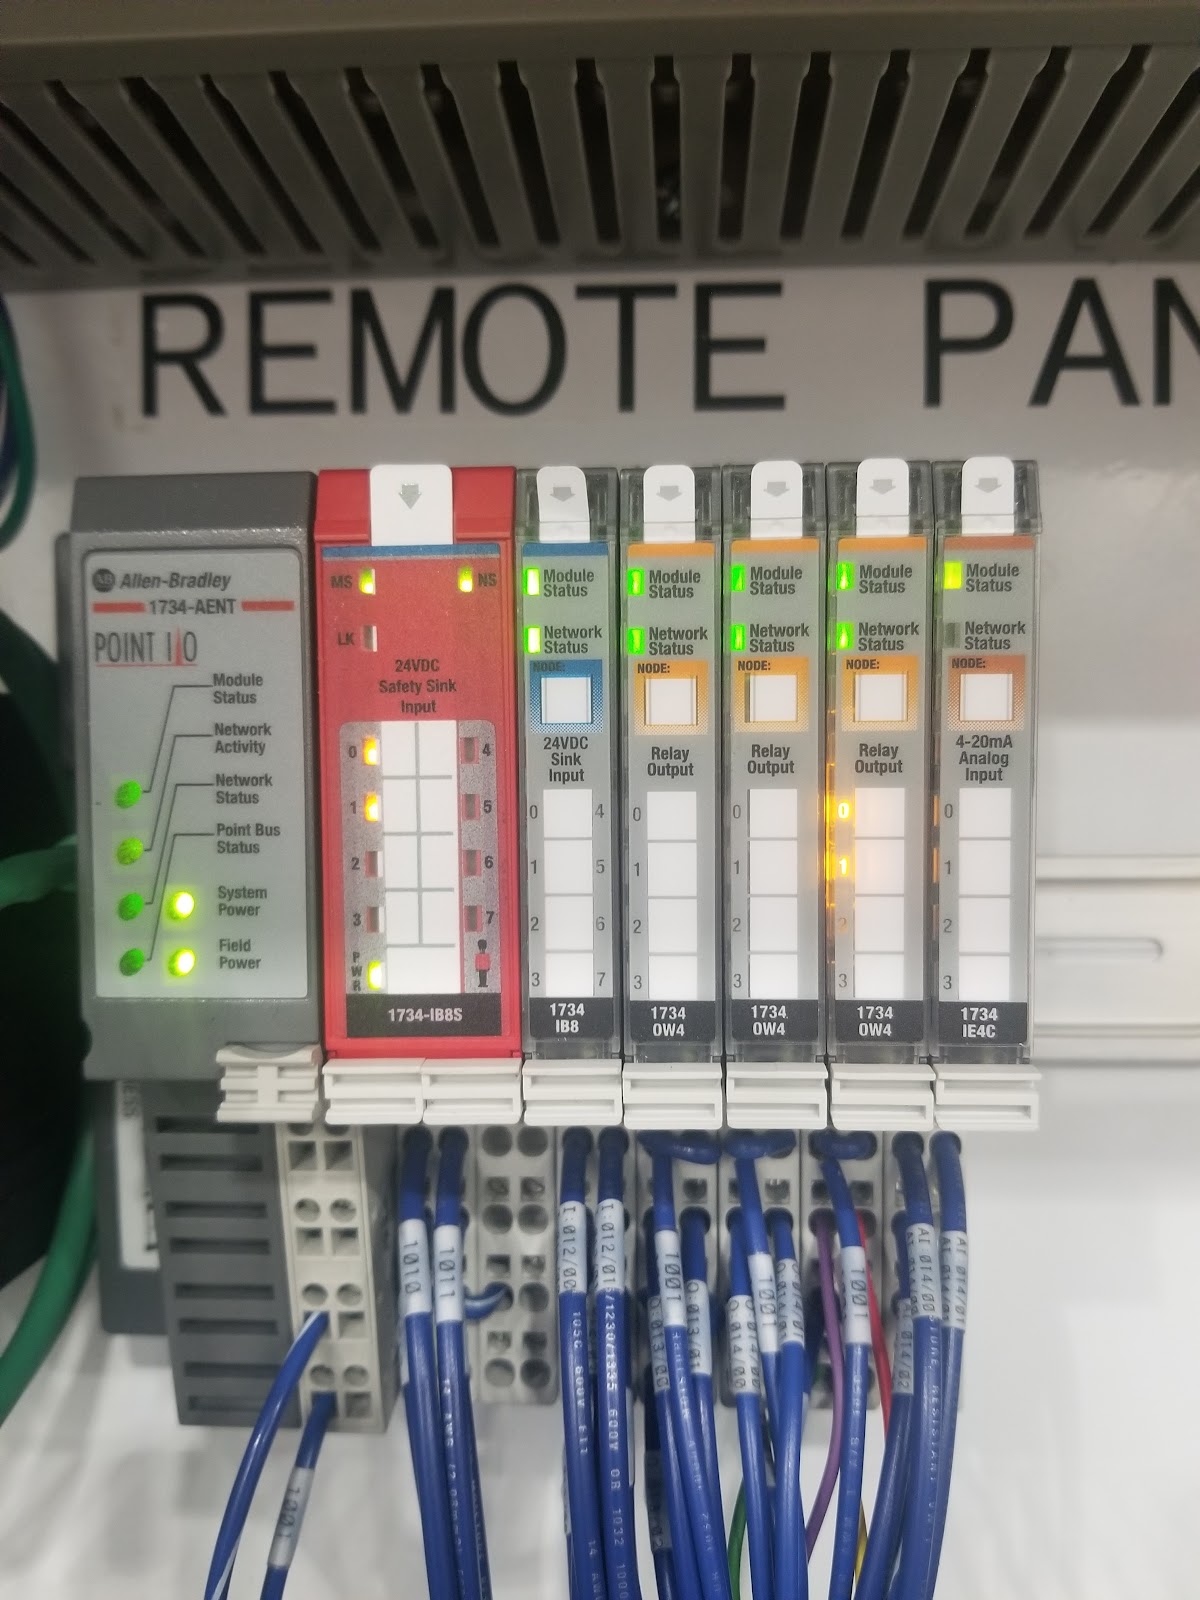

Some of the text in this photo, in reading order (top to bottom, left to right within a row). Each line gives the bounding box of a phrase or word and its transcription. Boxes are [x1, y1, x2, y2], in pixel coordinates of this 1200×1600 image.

[141, 282, 787, 417] REMOTE
[543, 568, 594, 583] Module
[649, 569, 701, 584] Module
[750, 566, 803, 580] Module
[859, 564, 912, 579] Module
[966, 563, 1019, 577] Module
[119, 572, 231, 591] Allen-Bradley
[331, 575, 353, 588] MS
[478, 573, 497, 587] NS
[859, 579, 905, 594] Status
[965, 578, 1012, 592] Status
[543, 584, 588, 597] Status
[649, 585, 694, 599] Status
[750, 581, 795, 595] Status
[149, 599, 236, 614] 1734-AENT
[544, 625, 602, 639] Network
[649, 626, 708, 641] Network
[750, 623, 809, 637] Network
[858, 622, 919, 636] Network
[964, 621, 1026, 635] Network
[338, 632, 355, 646] LK
[750, 638, 795, 652] Status
[858, 637, 904, 651] Status
[964, 636, 1011, 650] Status
[94, 631, 154, 663] POINT
[544, 641, 588, 654] Status
[649, 642, 694, 656] Status
[395, 659, 440, 673] 24VDC
[533, 661, 565, 672] NODE:
[637, 663, 670, 674] NODE:
[738, 660, 771, 671] NODE:
[846, 659, 880, 670] NODE:
[952, 658, 986, 669] NODE:
[213, 673, 263, 687] Module
[379, 679, 457, 695] Safety Sink
[213, 691, 257, 704] Status
[401, 700, 437, 715] Input
[214, 723, 271, 736] Network
[214, 740, 266, 755] Activity
[543, 736, 588, 751] 24VDC
[956, 735, 1013, 749] 4-20mA
[348, 745, 358, 758] 0
[482, 743, 491, 757] 4
[651, 746, 689, 763] Relay
[751, 744, 790, 760] Relay
[859, 743, 899, 760] Relay
[551, 752, 582, 766] Sink
[959, 751, 1009, 767] Analog
[647, 763, 694, 778] Output
[747, 760, 794, 776] Output
[855, 759, 903, 776] Output
[216, 774, 272, 787] Network
[549, 768, 585, 784] Input
[965, 767, 1003, 784] Input
[216, 791, 259, 804] Status
[350, 802, 357, 814] 1
[483, 800, 493, 813] 5
[529, 804, 538, 819] 0
[595, 803, 605, 818] 4
[733, 804, 742, 819] 0
[838, 802, 850, 819] 0
[944, 803, 953, 819] 0
[633, 806, 641, 822] 0
[217, 823, 281, 837] Point Bus
[217, 841, 260, 854] Status
[351, 857, 361, 870] 2
[484, 855, 494, 869] 6
[530, 859, 538, 874] 1
[595, 859, 605, 874] 5
[733, 860, 740, 875] 1
[839, 858, 848, 875] 1
[944, 860, 952, 875] 1
[634, 862, 640, 877] 1
[218, 886, 267, 901] System
[218, 904, 260, 916] Power
[352, 913, 362, 926] 3
[485, 911, 495, 924] 7
[530, 916, 540, 931] 2
[595, 916, 605, 931] 6
[732, 917, 742, 932] 2
[838, 917, 847, 932] 2
[633, 919, 642, 934] 2
[943, 918, 953, 933] 2
[219, 939, 251, 952] Field
[219, 957, 261, 969] Power
[531, 972, 540, 987] 3
[597, 972, 606, 987] 7
[634, 975, 643, 990] 3
[733, 973, 742, 988] 3
[838, 973, 848, 988] 3
[943, 975, 953, 990] 3
[388, 1008, 463, 1023] 1734-IB8S
[550, 1003, 585, 1017] 1734
[651, 1006, 686, 1020] 1734
[751, 1005, 786, 1019] 1734
[857, 1005, 894, 1019] 1734
[961, 1007, 998, 1021] 1734
[556, 1019, 579, 1033] IB8
[962, 1024, 996, 1038] IE4C
